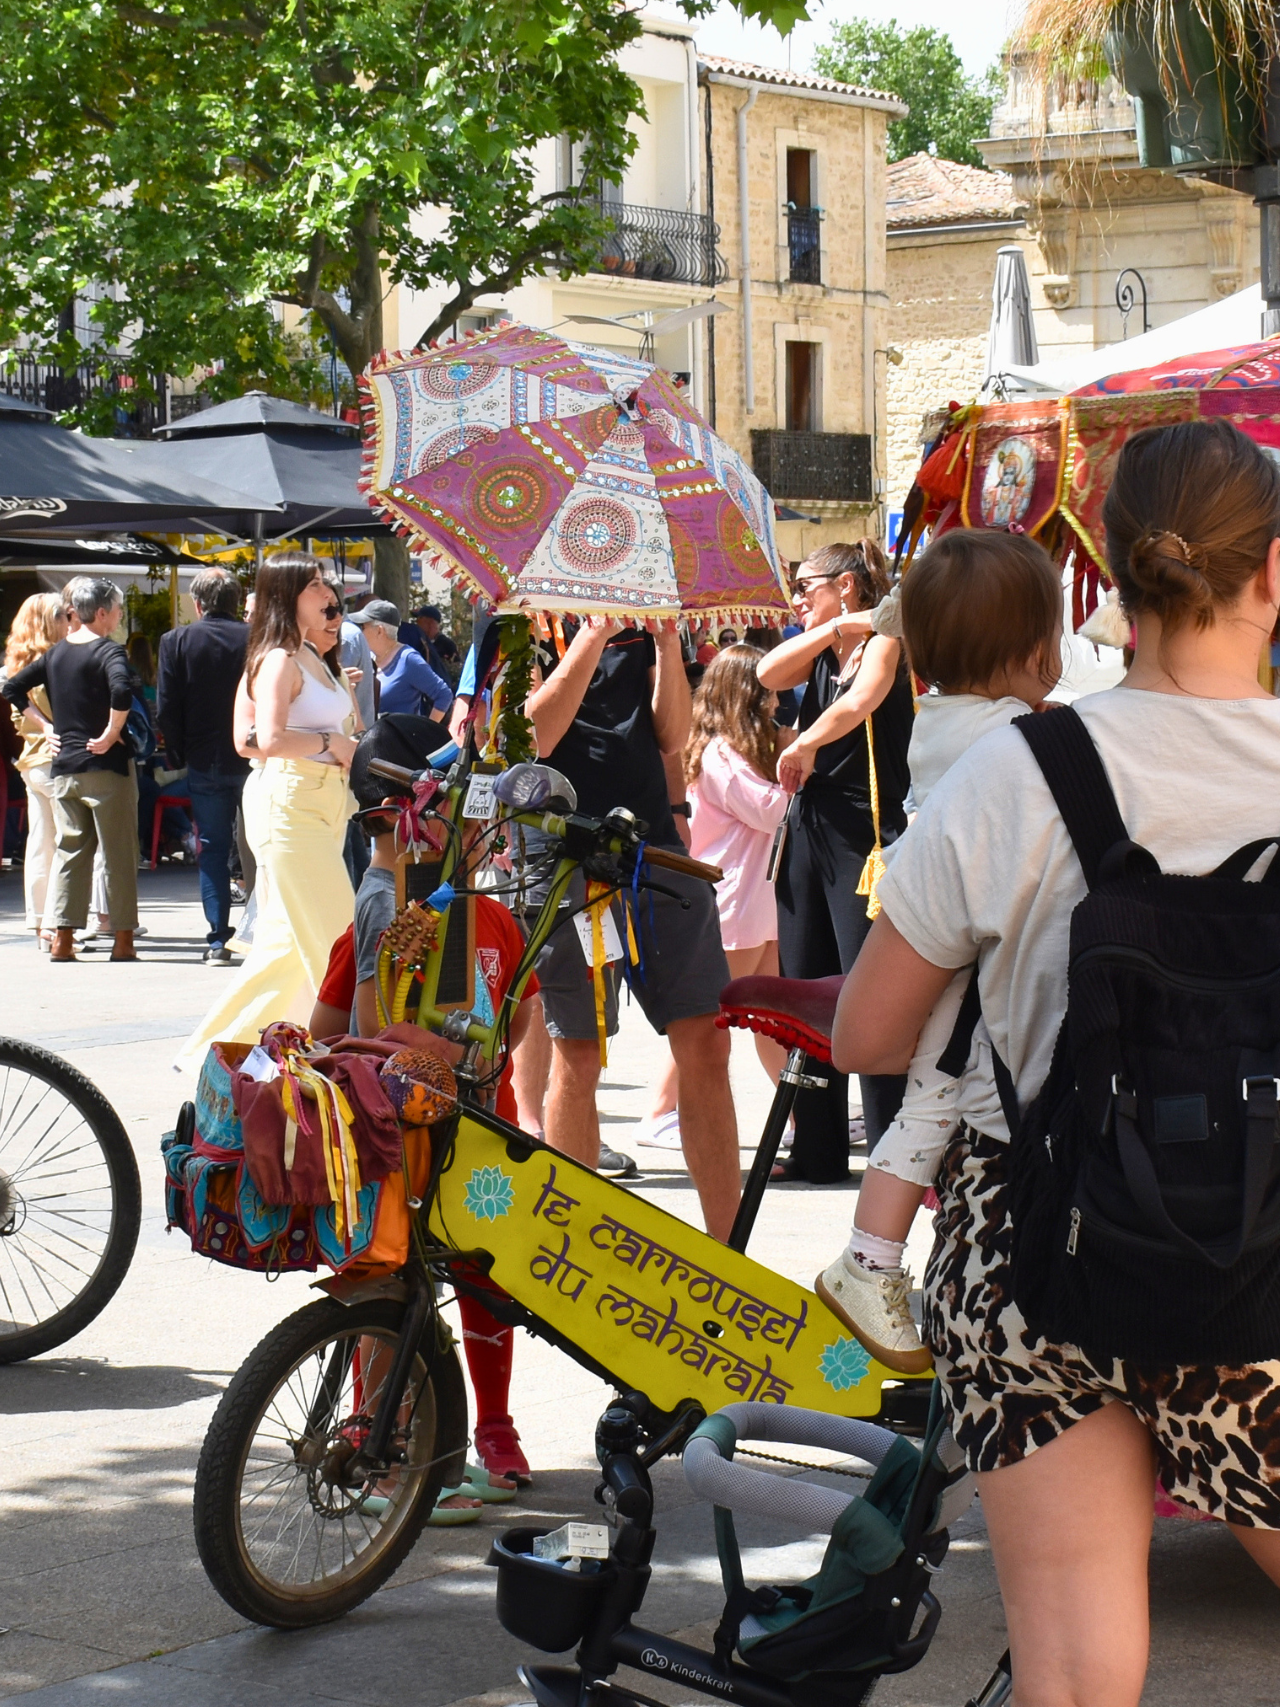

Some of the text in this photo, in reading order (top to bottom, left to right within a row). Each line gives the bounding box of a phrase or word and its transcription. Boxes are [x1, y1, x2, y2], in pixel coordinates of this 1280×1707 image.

[529, 1232, 593, 1303] du
[532, 1163, 808, 1352] le carrousel
[670, 1662, 734, 1693] Kinderkraft
